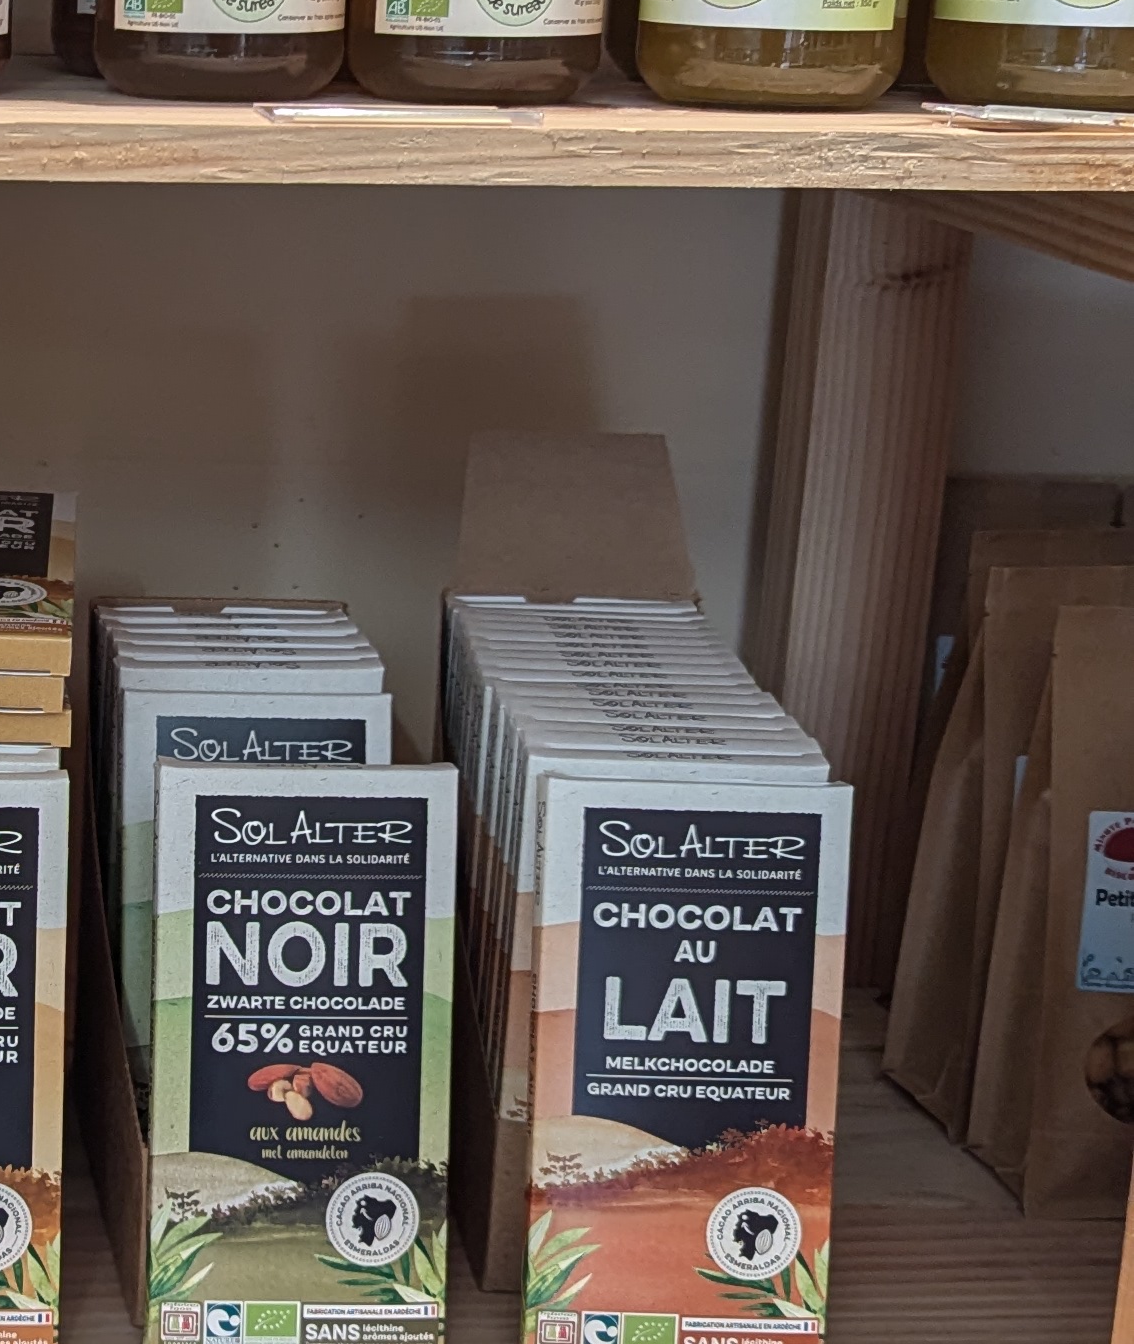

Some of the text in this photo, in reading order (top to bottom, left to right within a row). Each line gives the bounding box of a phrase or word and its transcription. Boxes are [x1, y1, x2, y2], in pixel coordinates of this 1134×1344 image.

[206, 889, 411, 916] CHOCOLAT
[593, 903, 802, 932] CHOCOLAT
[206, 921, 408, 987] NOIR
[674, 940, 717, 963] AU
[207, 995, 405, 1011] ZWARTE CHOCOLADE
[604, 976, 786, 1044] LAIT
[211, 1022, 293, 1054] 65%
[299, 1025, 407, 1037] GRAND CRU
[299, 1041, 407, 1056] EQUATEUR
[606, 1056, 775, 1074] MELKCHOCOLADE
[587, 1082, 791, 1101] GRAND CRU EQUATEUR
[286, 1121, 361, 1142] amandes
